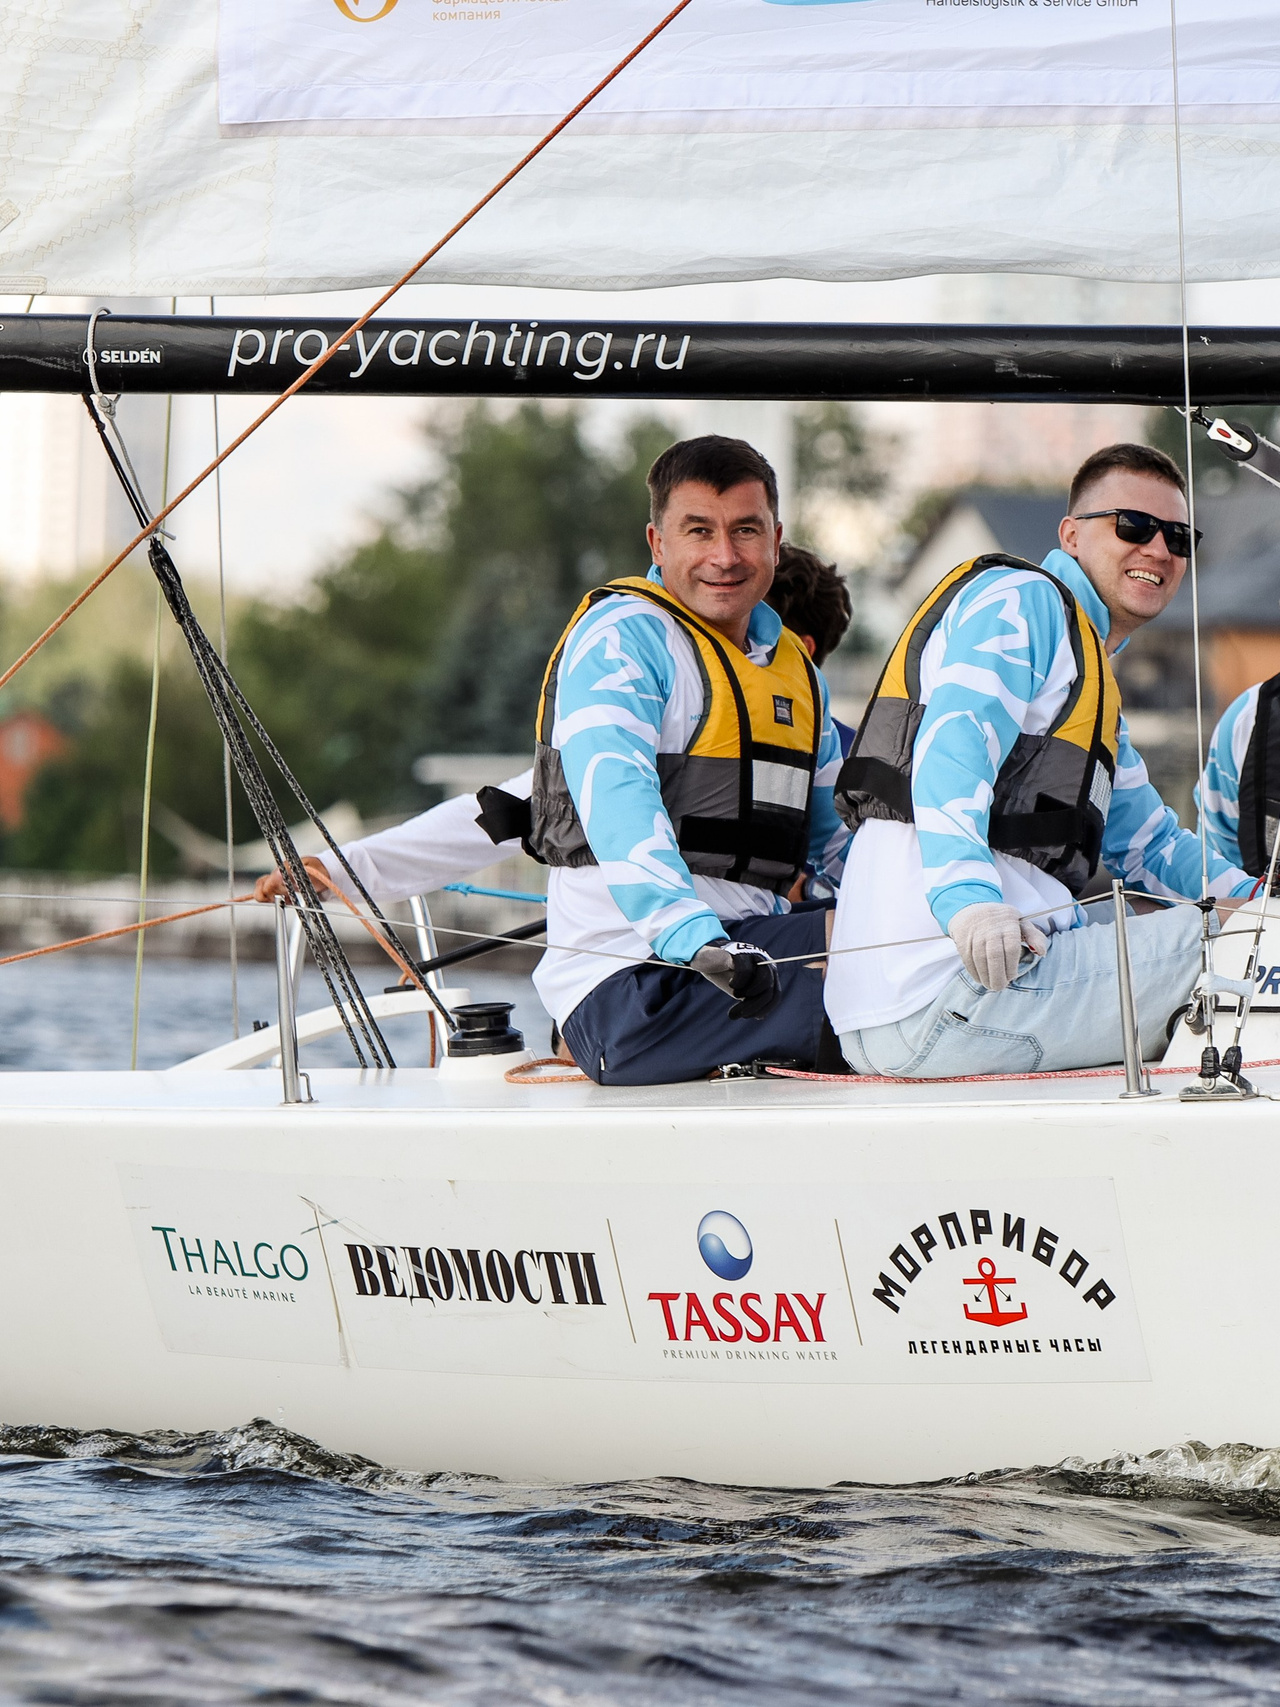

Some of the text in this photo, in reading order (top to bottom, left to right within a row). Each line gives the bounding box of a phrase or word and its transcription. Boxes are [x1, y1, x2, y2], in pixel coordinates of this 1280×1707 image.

[432, 10, 501, 21] компания
[100, 347, 161, 364] SELDÉN
[228, 321, 691, 380] pro-yachting.ru
[872, 1209, 1117, 1314] МОРПРИБОР
[343, 1243, 607, 1307] ВЕДОМОСТИ
[188, 1285, 297, 1303] LA BEAUTÉ MARINE
[647, 1292, 828, 1343] TASSAY
[662, 1349, 838, 1361] PREMIUM DRINKING WATER
[908, 1338, 1102, 1356] ЛЕГЕНДАРНЫЕ ЧАСЫ
